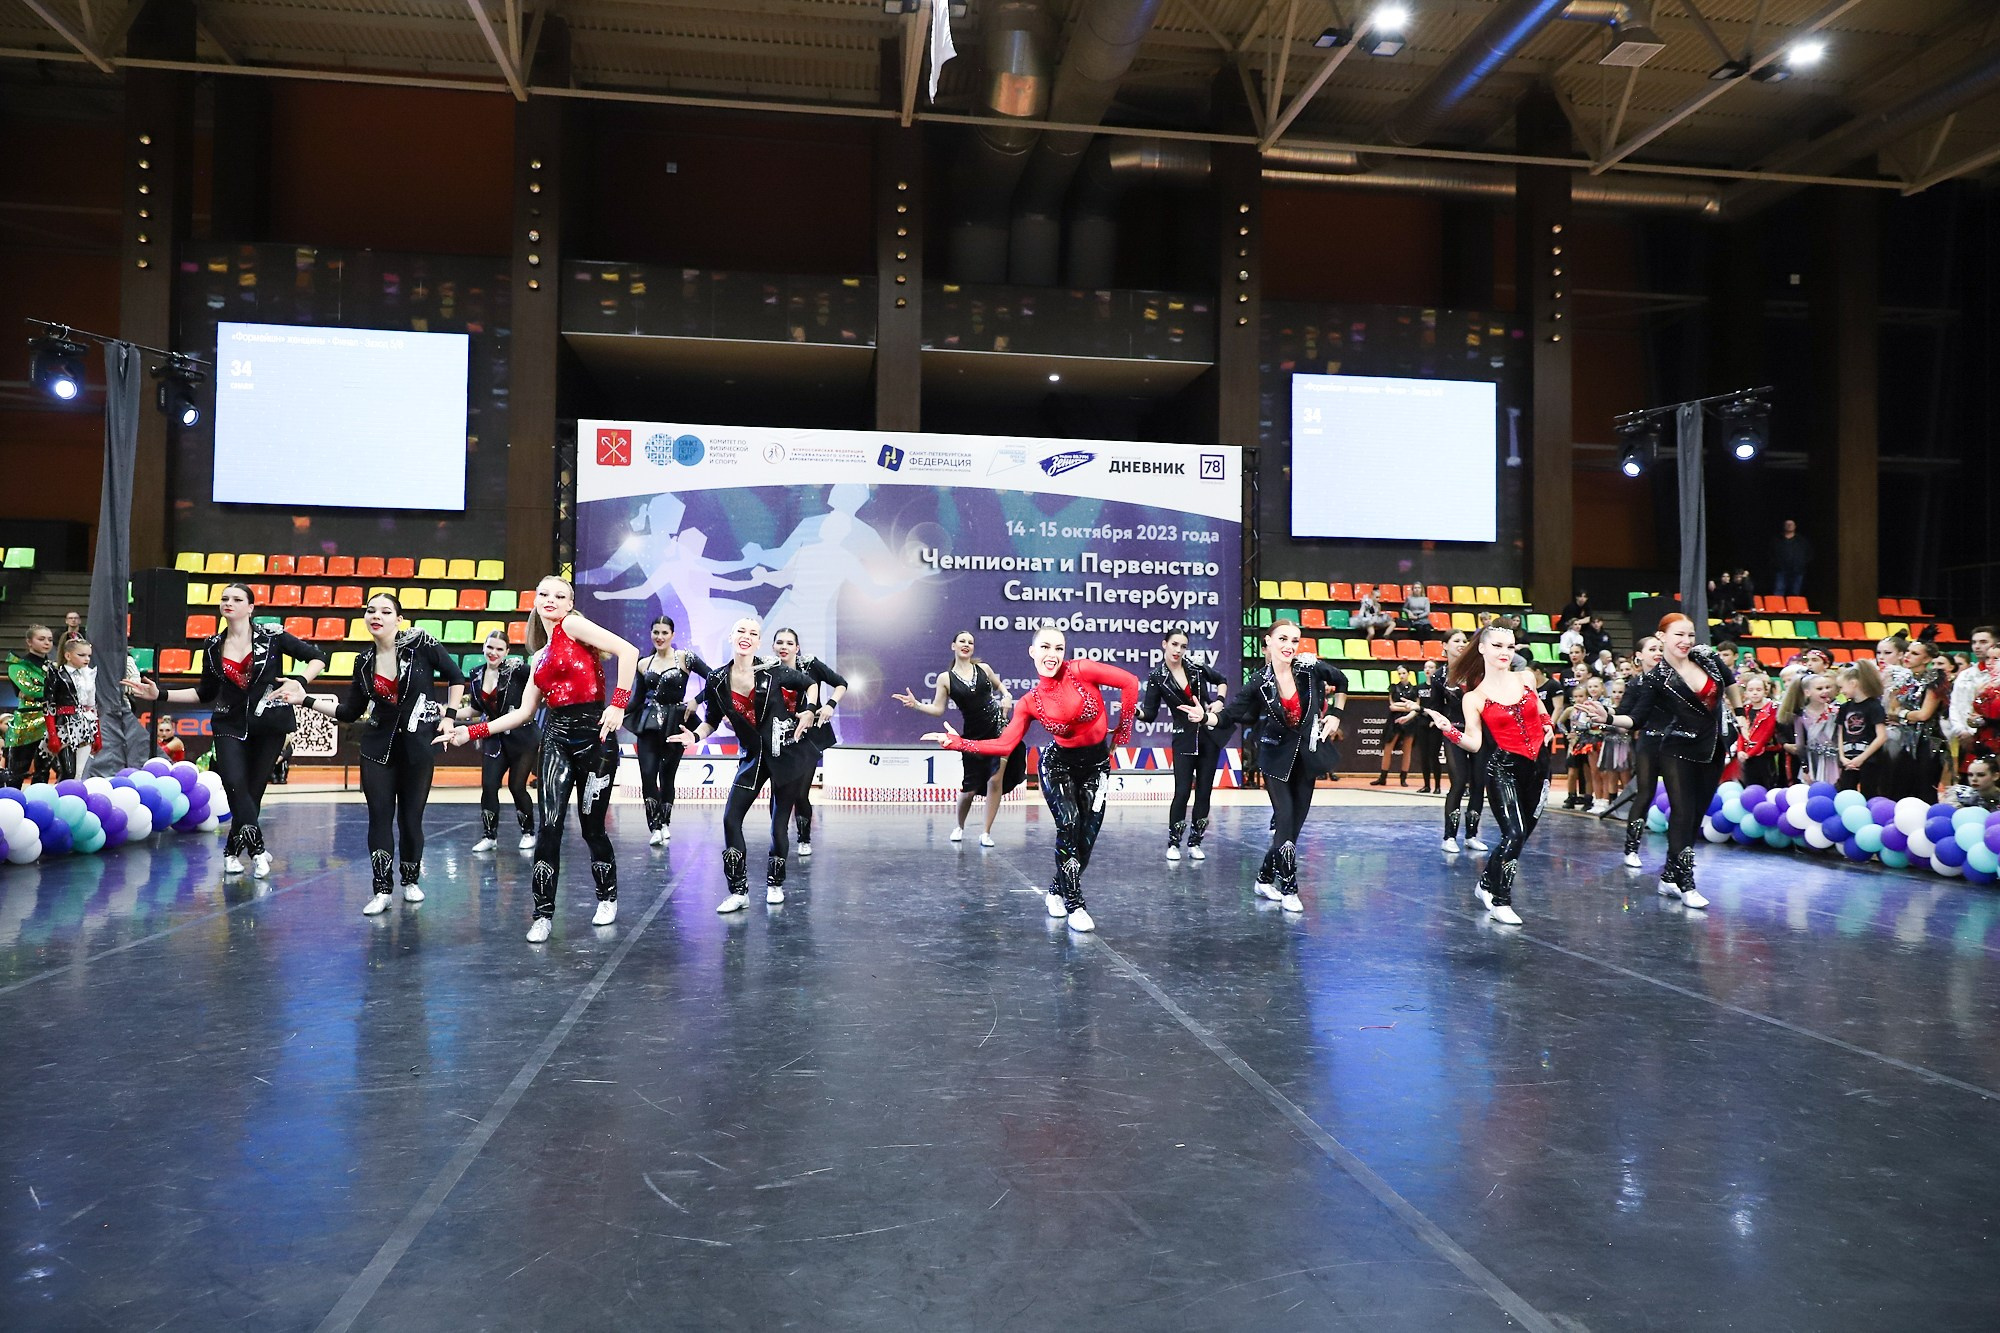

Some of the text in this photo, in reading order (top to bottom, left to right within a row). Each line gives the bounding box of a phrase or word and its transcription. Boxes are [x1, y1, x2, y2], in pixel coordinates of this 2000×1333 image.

[231, 360, 252, 377] 34
[1304, 407, 1321, 423] 34
[909, 457, 972, 468] ФЕДЕРАЦИЯ
[1109, 460, 1185, 475] ДНЕВНИК
[1204, 460, 1221, 474] 78
[1005, 520, 1026, 537] 14
[1040, 521, 1057, 537] 15
[1061, 523, 1133, 543] октября
[1136, 524, 1177, 541] 2023
[1182, 530, 1219, 544] года
[922, 548, 1220, 578] Чемпионат и Первенство
[1003, 579, 1219, 610] Санкт-Петербурга
[979, 614, 1009, 631] по
[1073, 647, 1220, 668] рок-н-рлу
[1362, 738, 1380, 746] спор
[702, 763, 715, 785] 2
[923, 755, 938, 785] 1
[1115, 777, 1124, 791] 3
